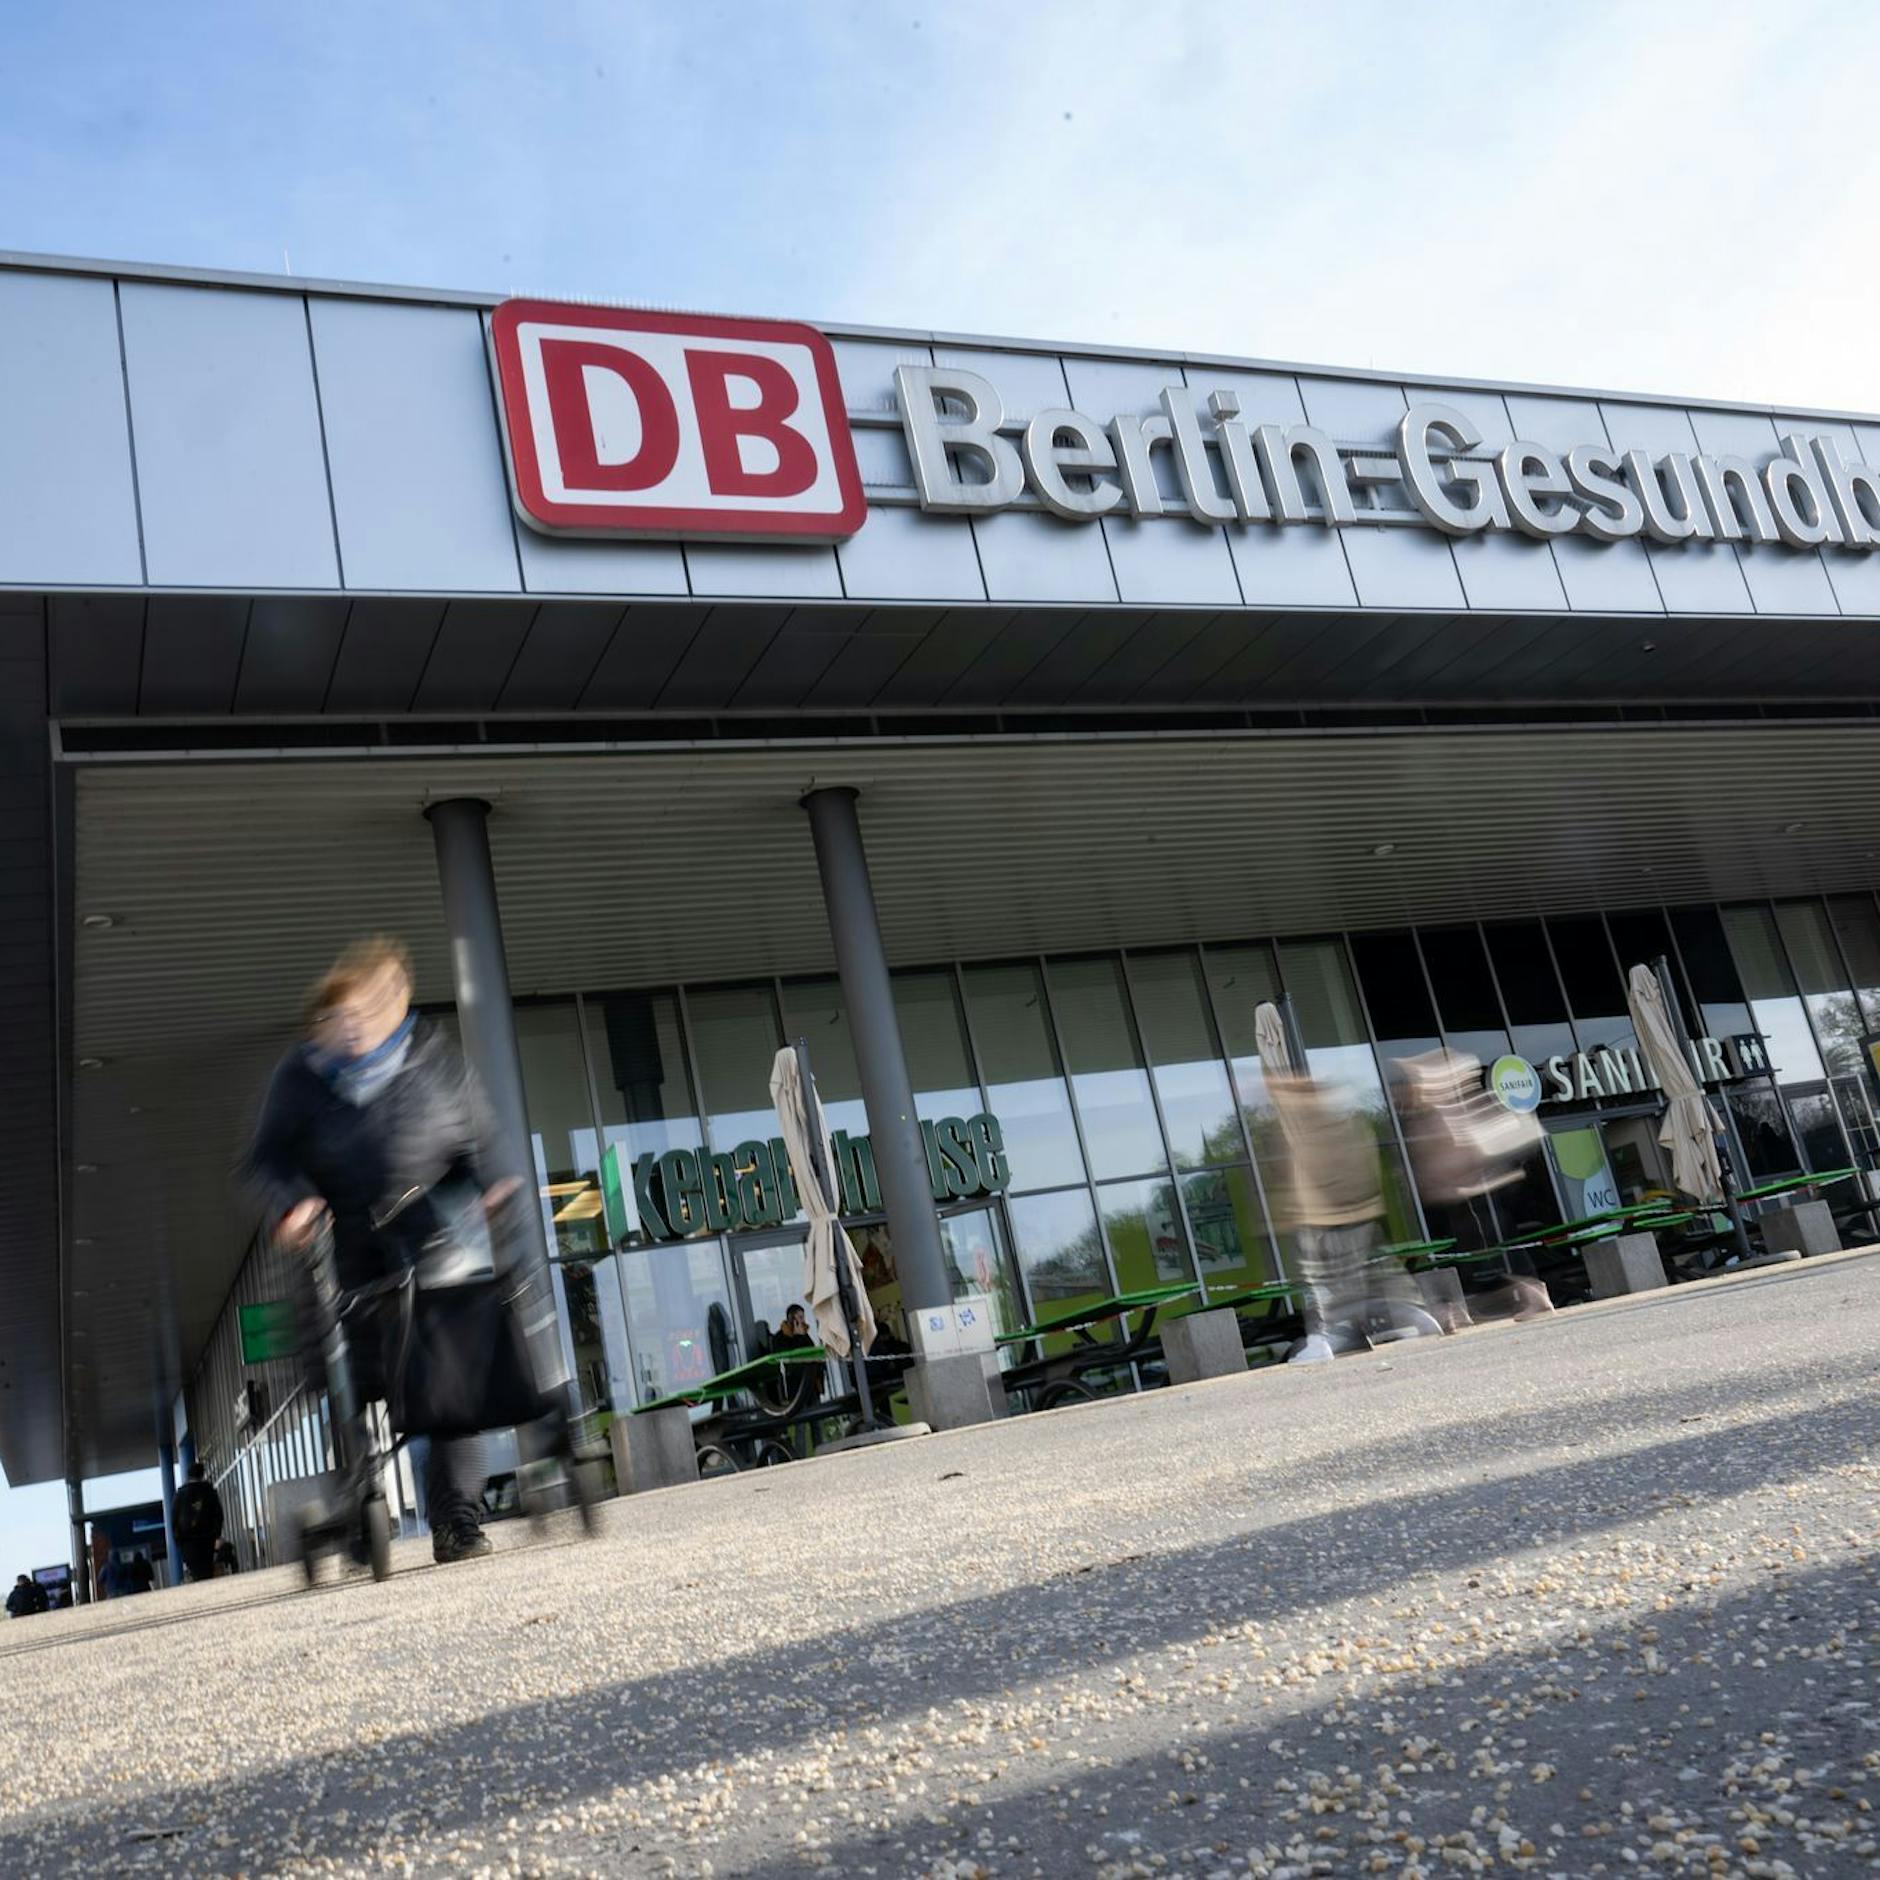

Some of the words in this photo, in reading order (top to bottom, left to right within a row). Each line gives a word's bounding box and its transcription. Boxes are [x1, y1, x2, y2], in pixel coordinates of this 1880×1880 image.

[539, 338, 818, 498] DB
[1500, 1079, 1533, 1090] SANIFAIR
[1549, 1037, 1731, 1102] SANIIR
[1587, 1188, 1616, 1208] WC
